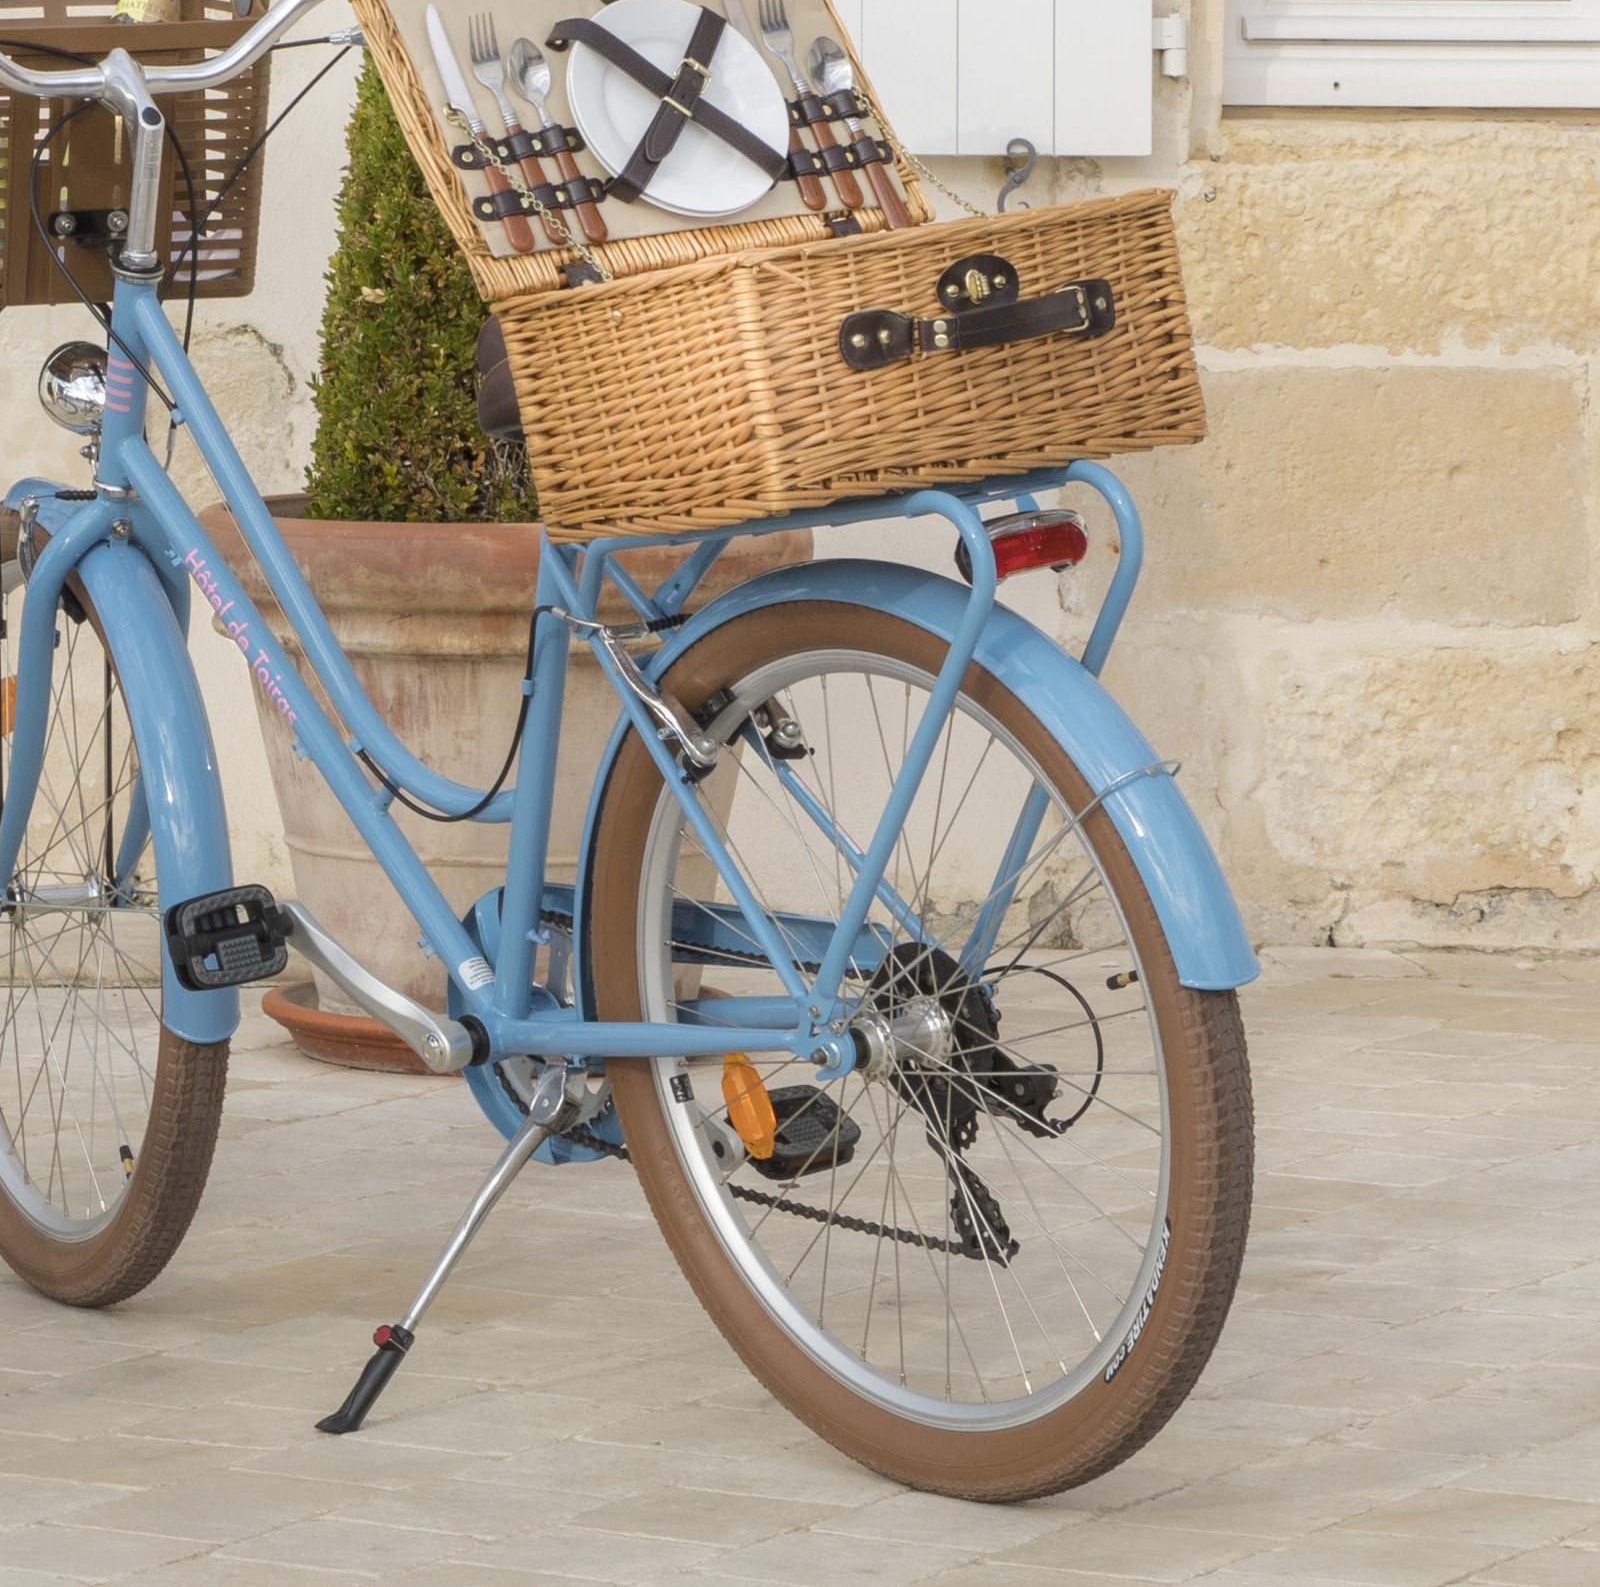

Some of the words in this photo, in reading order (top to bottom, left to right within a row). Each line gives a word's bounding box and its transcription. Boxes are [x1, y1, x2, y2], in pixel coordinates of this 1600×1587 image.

[184, 547, 235, 616] Hôtel
[228, 621, 249, 652] de
[253, 648, 298, 727] Toiras
